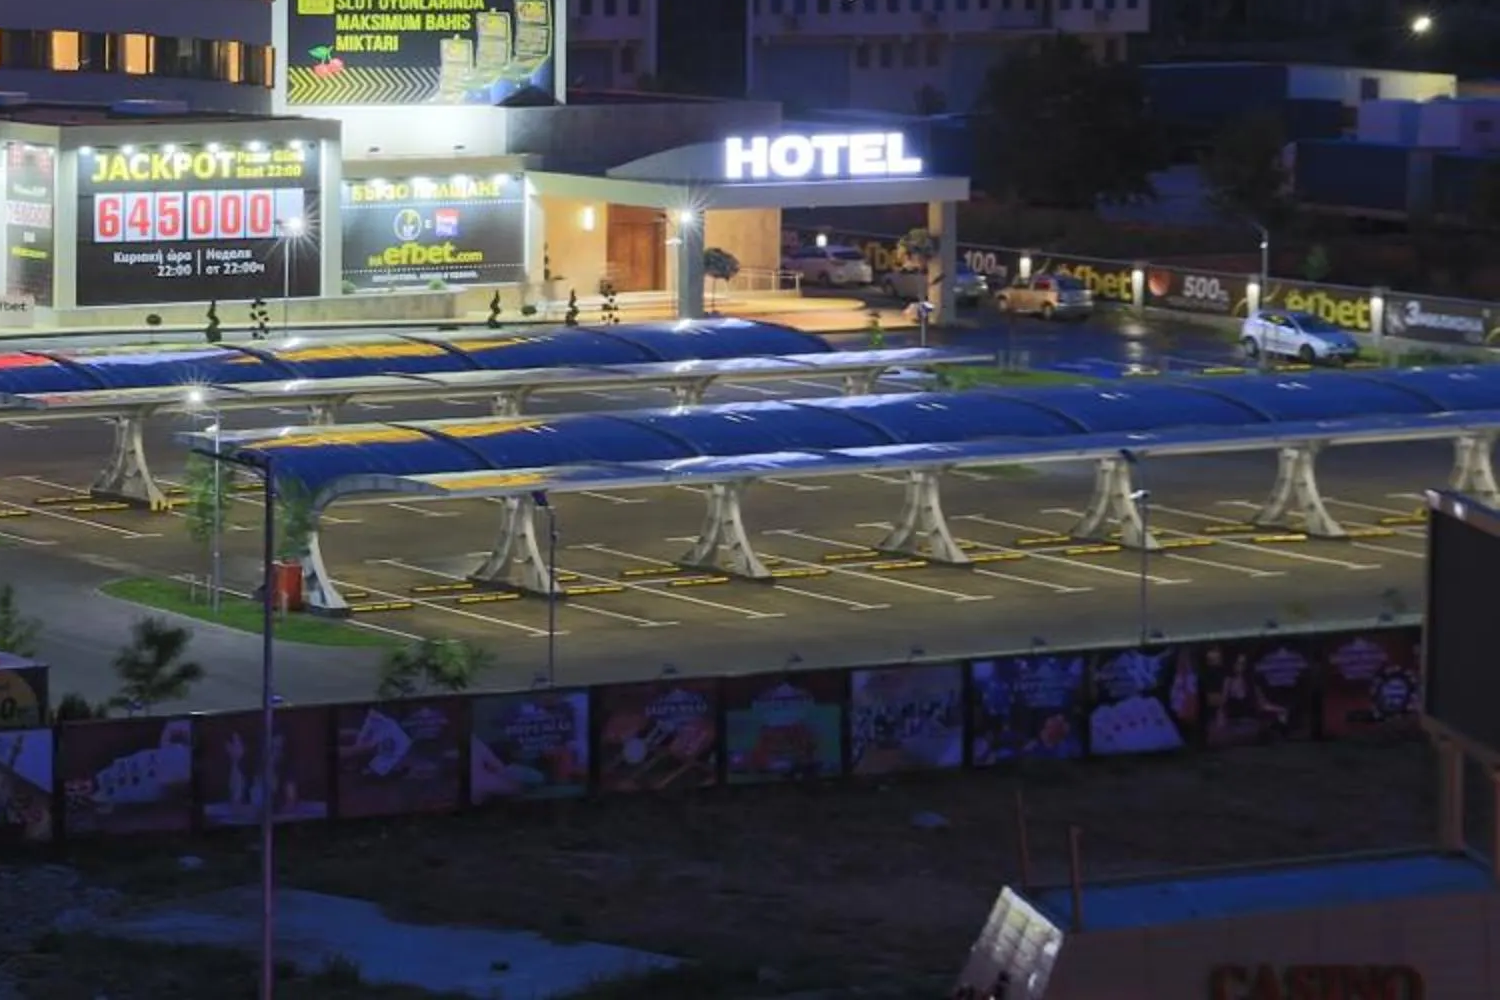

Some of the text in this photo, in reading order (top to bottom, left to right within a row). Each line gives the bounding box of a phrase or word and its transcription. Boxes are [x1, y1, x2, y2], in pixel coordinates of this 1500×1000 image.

[92, 151, 235, 182] JACKPOT
[725, 133, 922, 179] HOTEL
[963, 249, 997, 275] 100
